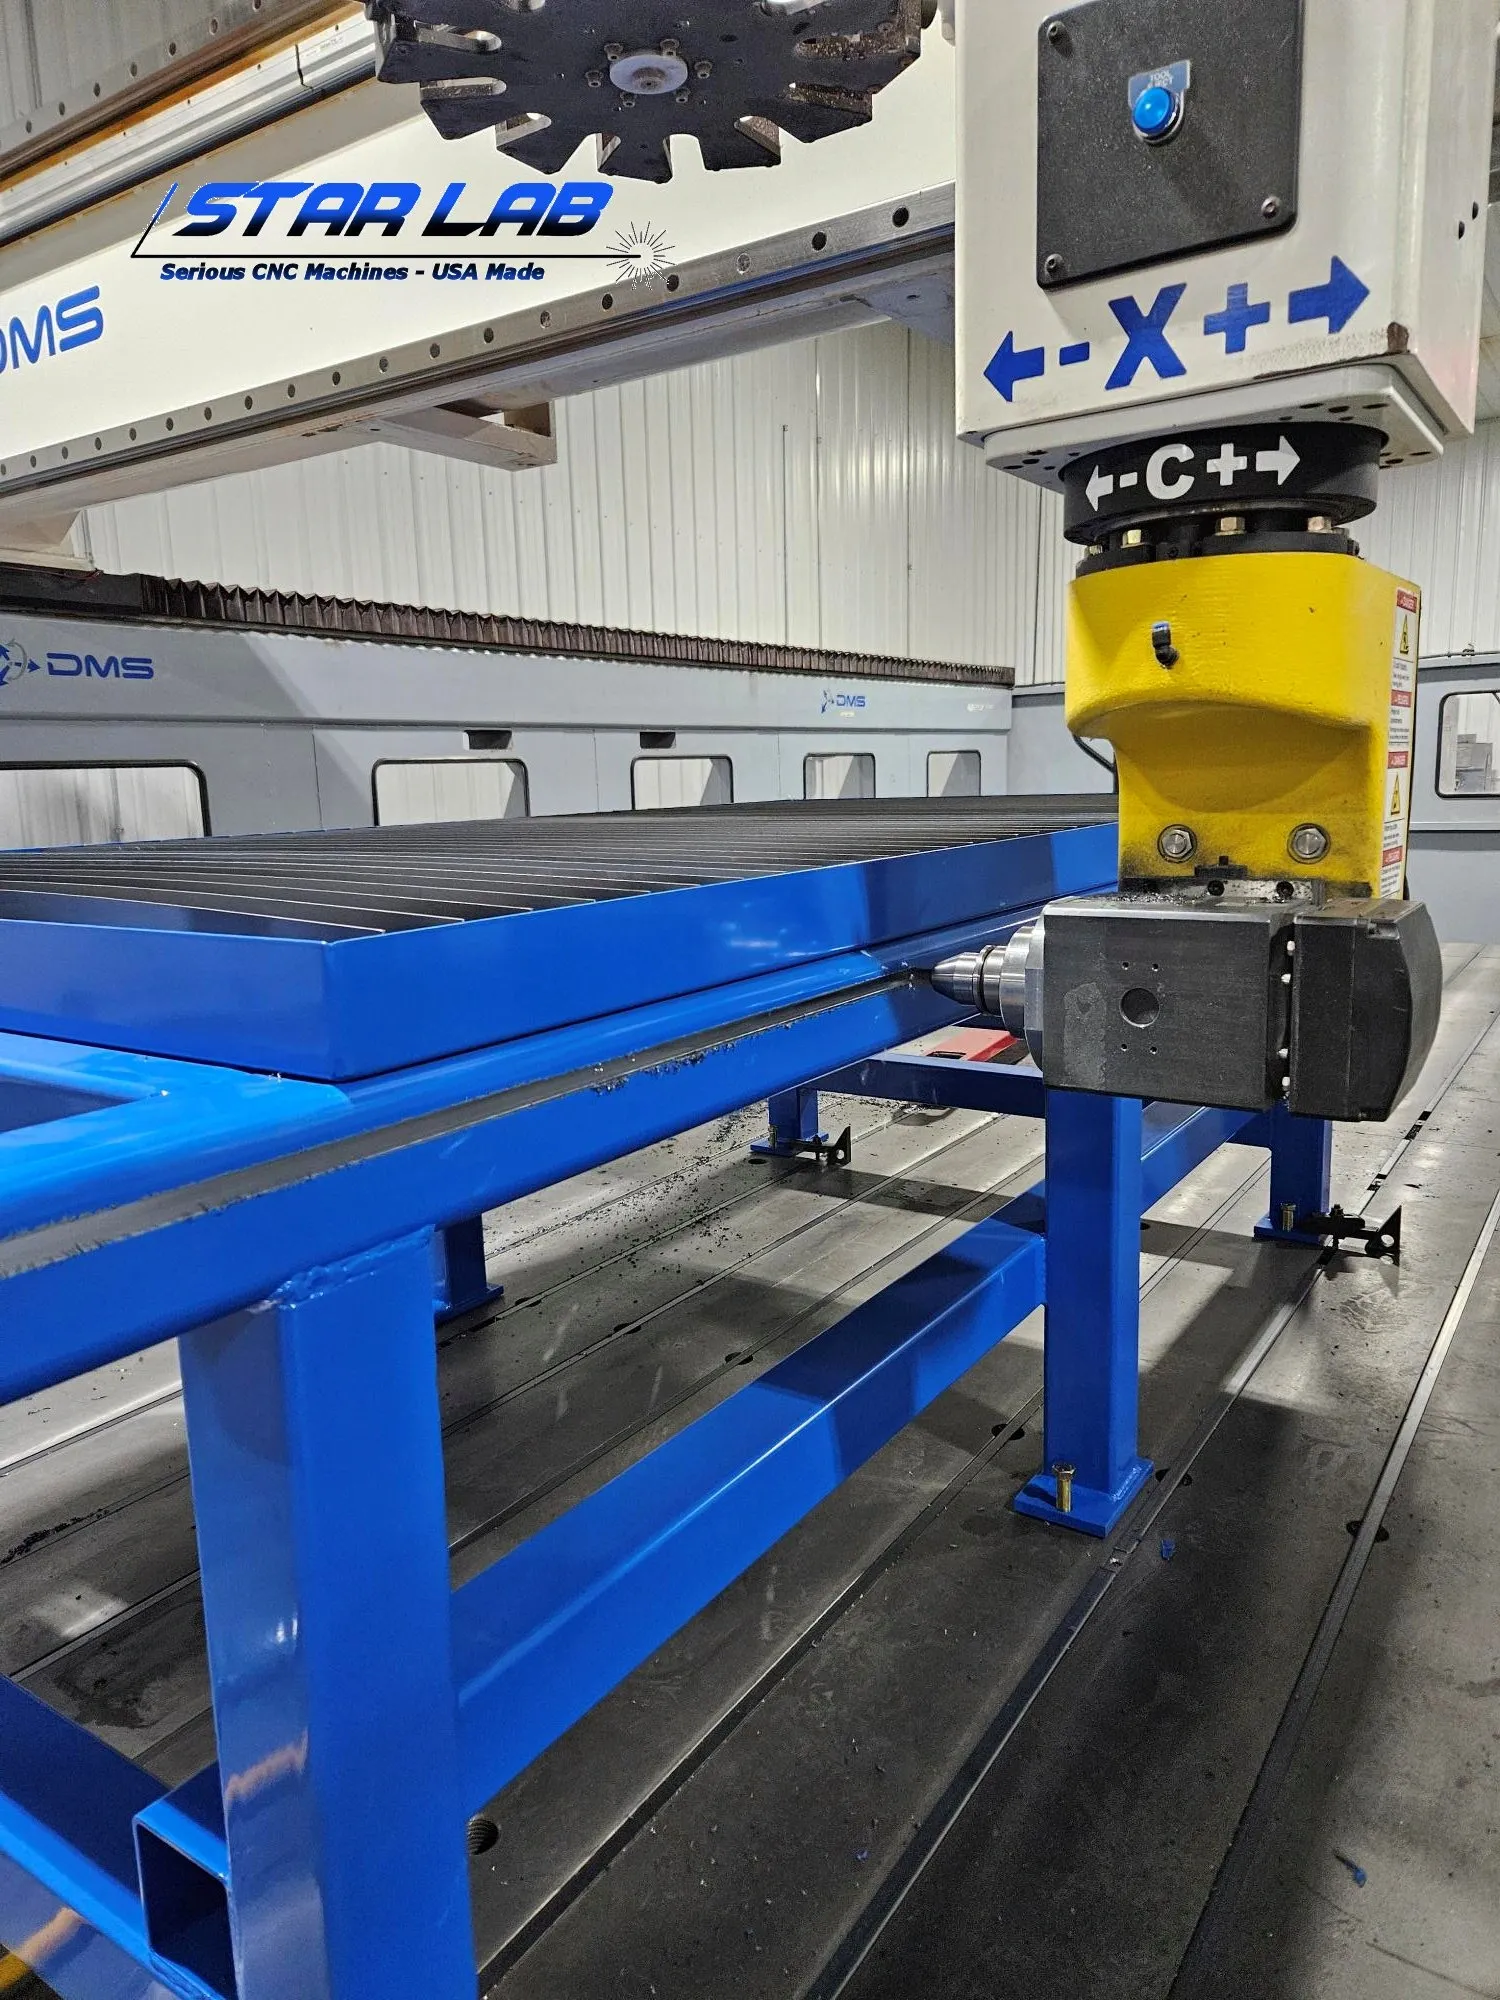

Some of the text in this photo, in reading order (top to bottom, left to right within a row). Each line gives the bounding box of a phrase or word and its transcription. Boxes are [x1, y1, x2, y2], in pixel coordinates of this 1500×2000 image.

[0, 285, 104, 375] MS
[46, 652, 154, 680] DMS
[836, 694, 866, 708] DMS
